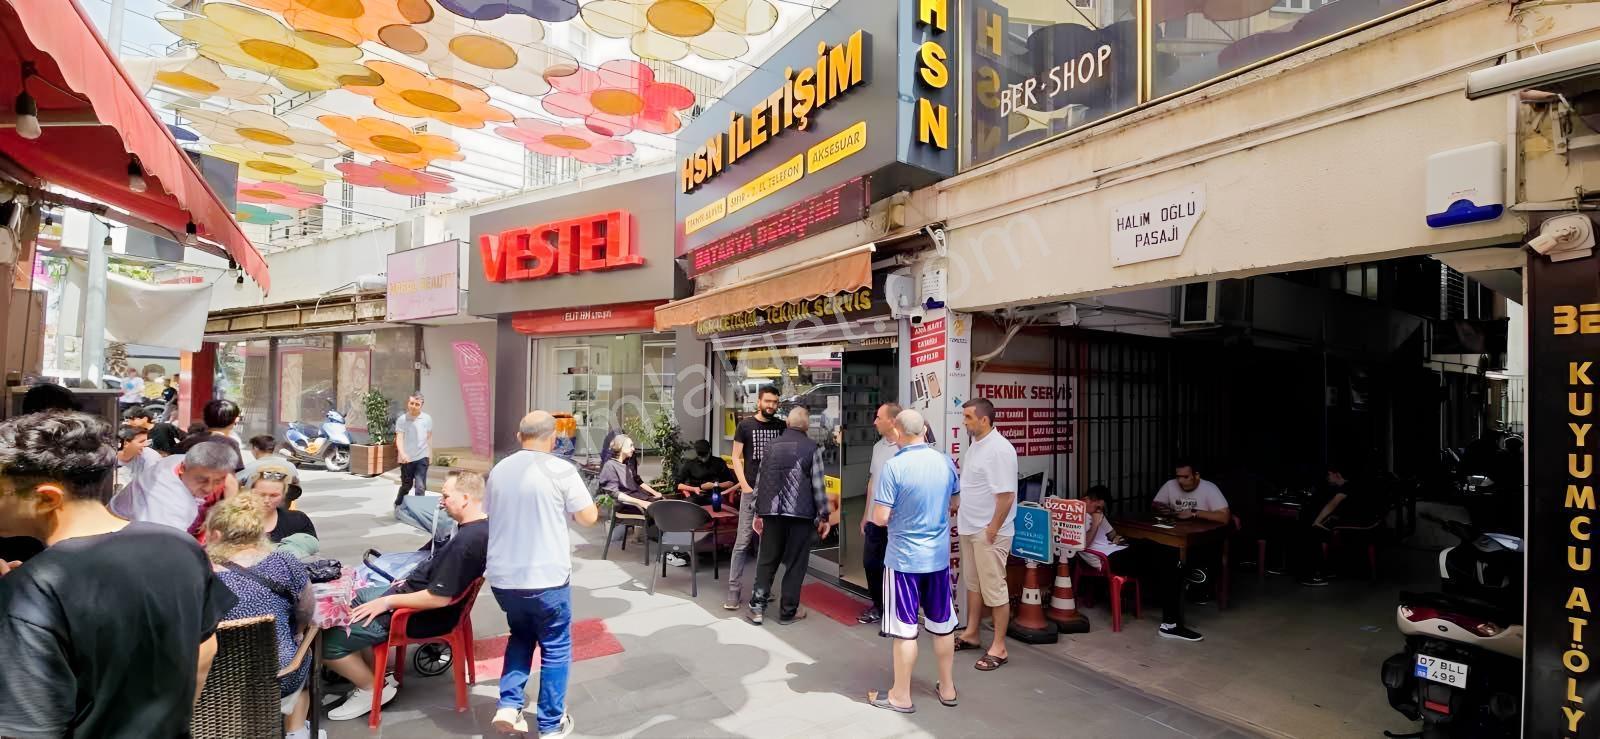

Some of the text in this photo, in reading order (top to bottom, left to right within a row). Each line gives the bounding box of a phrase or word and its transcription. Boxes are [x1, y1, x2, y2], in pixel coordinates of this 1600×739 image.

[919, 0, 949, 149] HSN
[682, 29, 864, 192] HSN İLETİŞİM
[812, 131, 860, 164] AKSESUAR
[768, 163, 799, 188] TELEFON
[480, 208, 645, 283] VESTEL
[976, 381, 1027, 399] TEKNİK
[1564, 361, 1597, 571] KUYUMCU
[1045, 499, 1084, 513] ÖZCAN
[1420, 657, 1464, 675] 07 BLL
[1431, 671, 1456, 683] 498
[1562, 587, 1592, 739] ATÖLY
